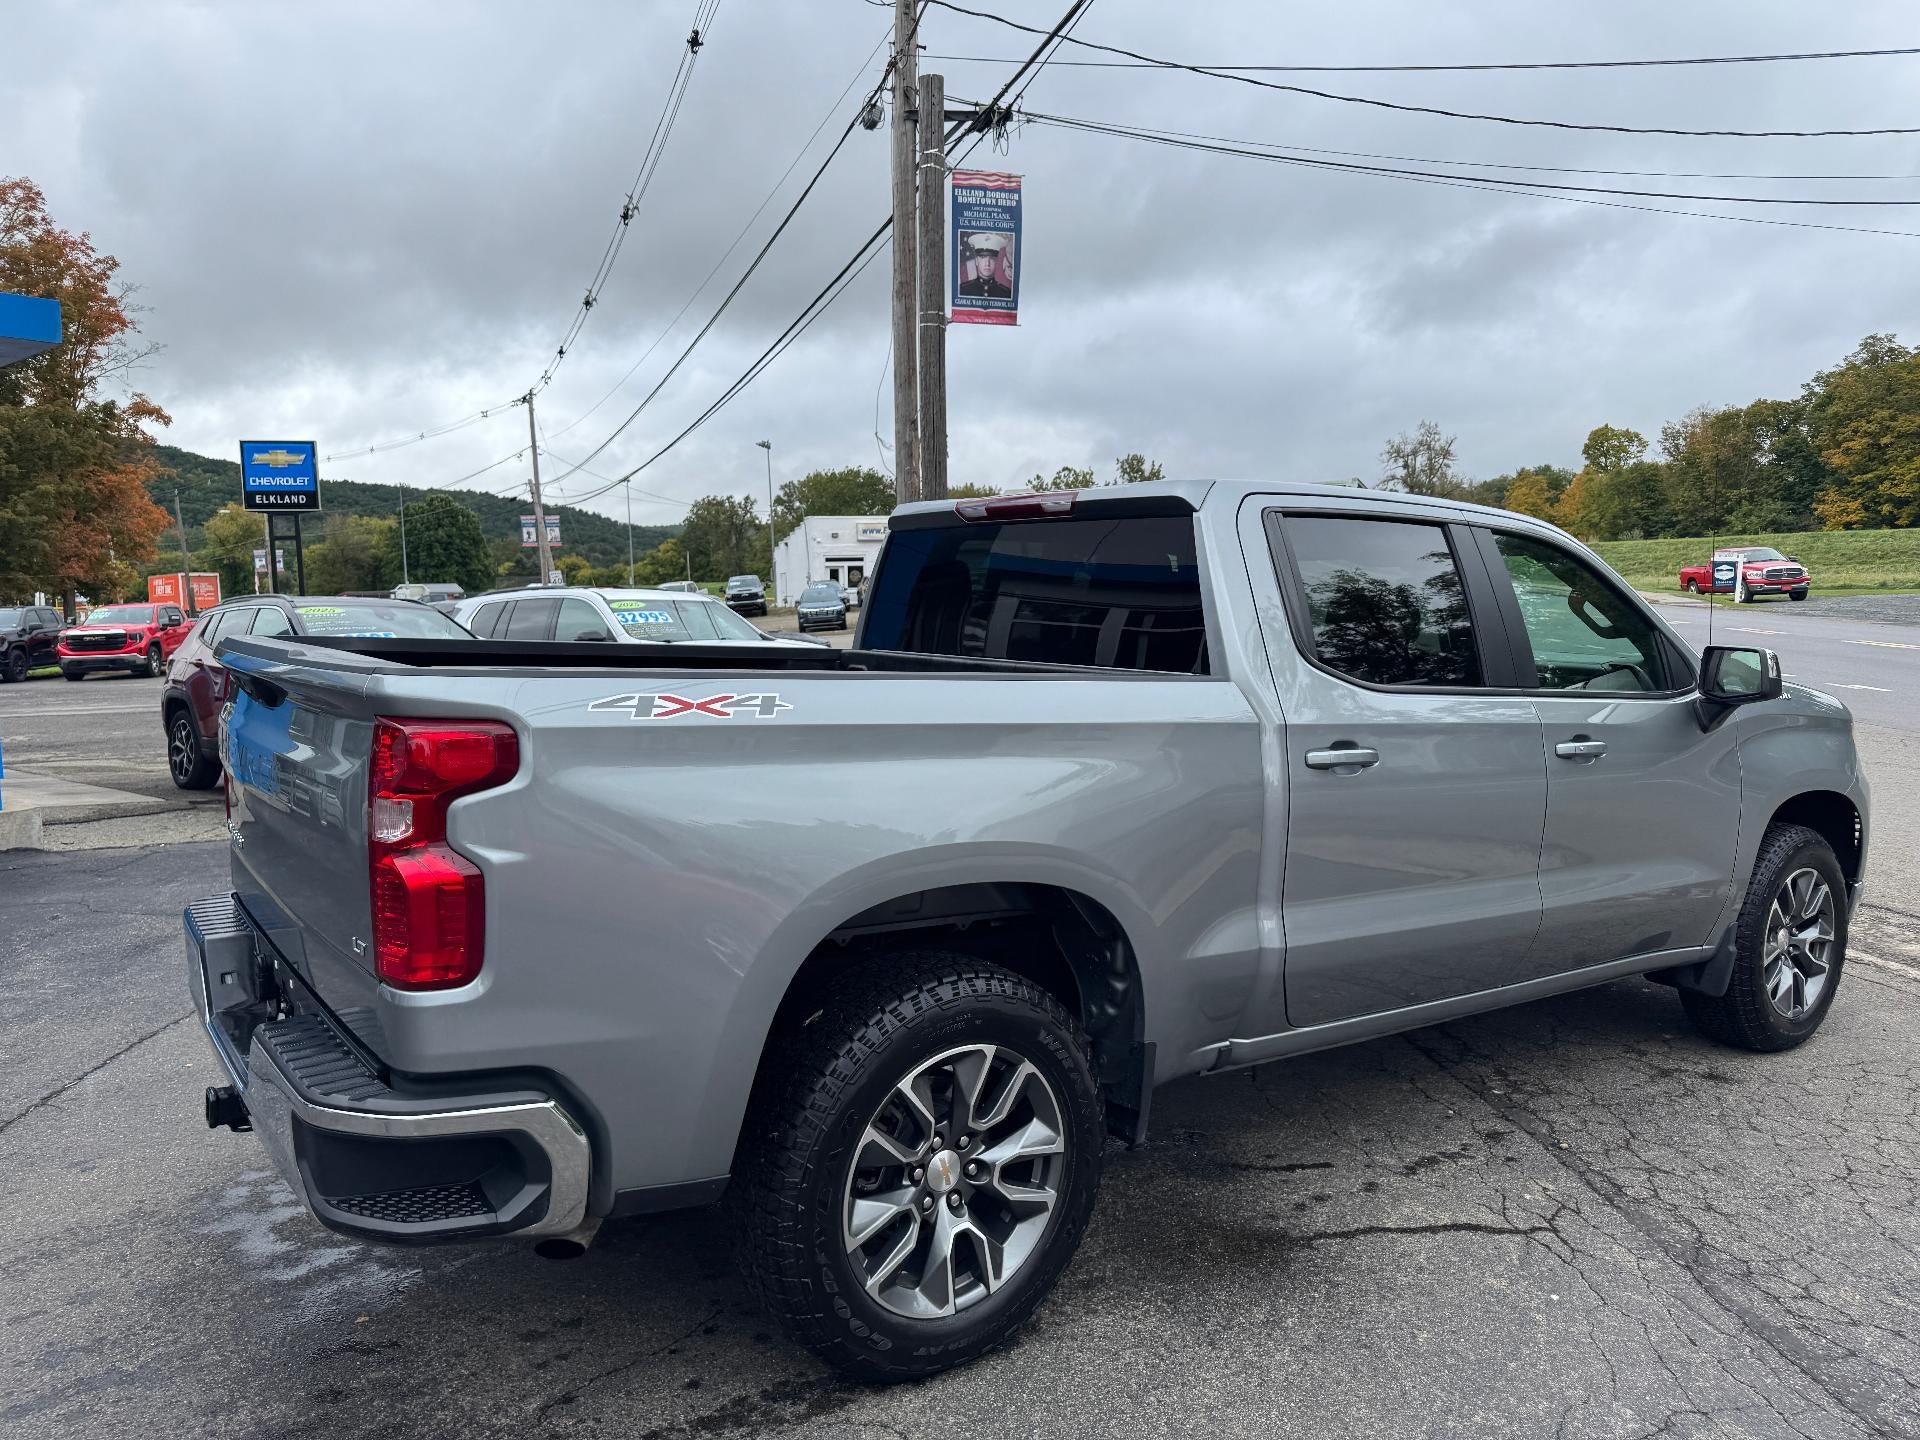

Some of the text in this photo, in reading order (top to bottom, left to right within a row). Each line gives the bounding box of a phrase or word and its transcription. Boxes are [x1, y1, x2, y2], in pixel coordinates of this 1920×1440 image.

[955, 188, 1019, 200] ELKLAND BOROUGH
[957, 196, 1016, 207] HOMETOWN HERO
[249, 477, 309, 486] CHEVROLET
[255, 495, 307, 504] ELKLAND
[616, 611, 669, 624] 32995
